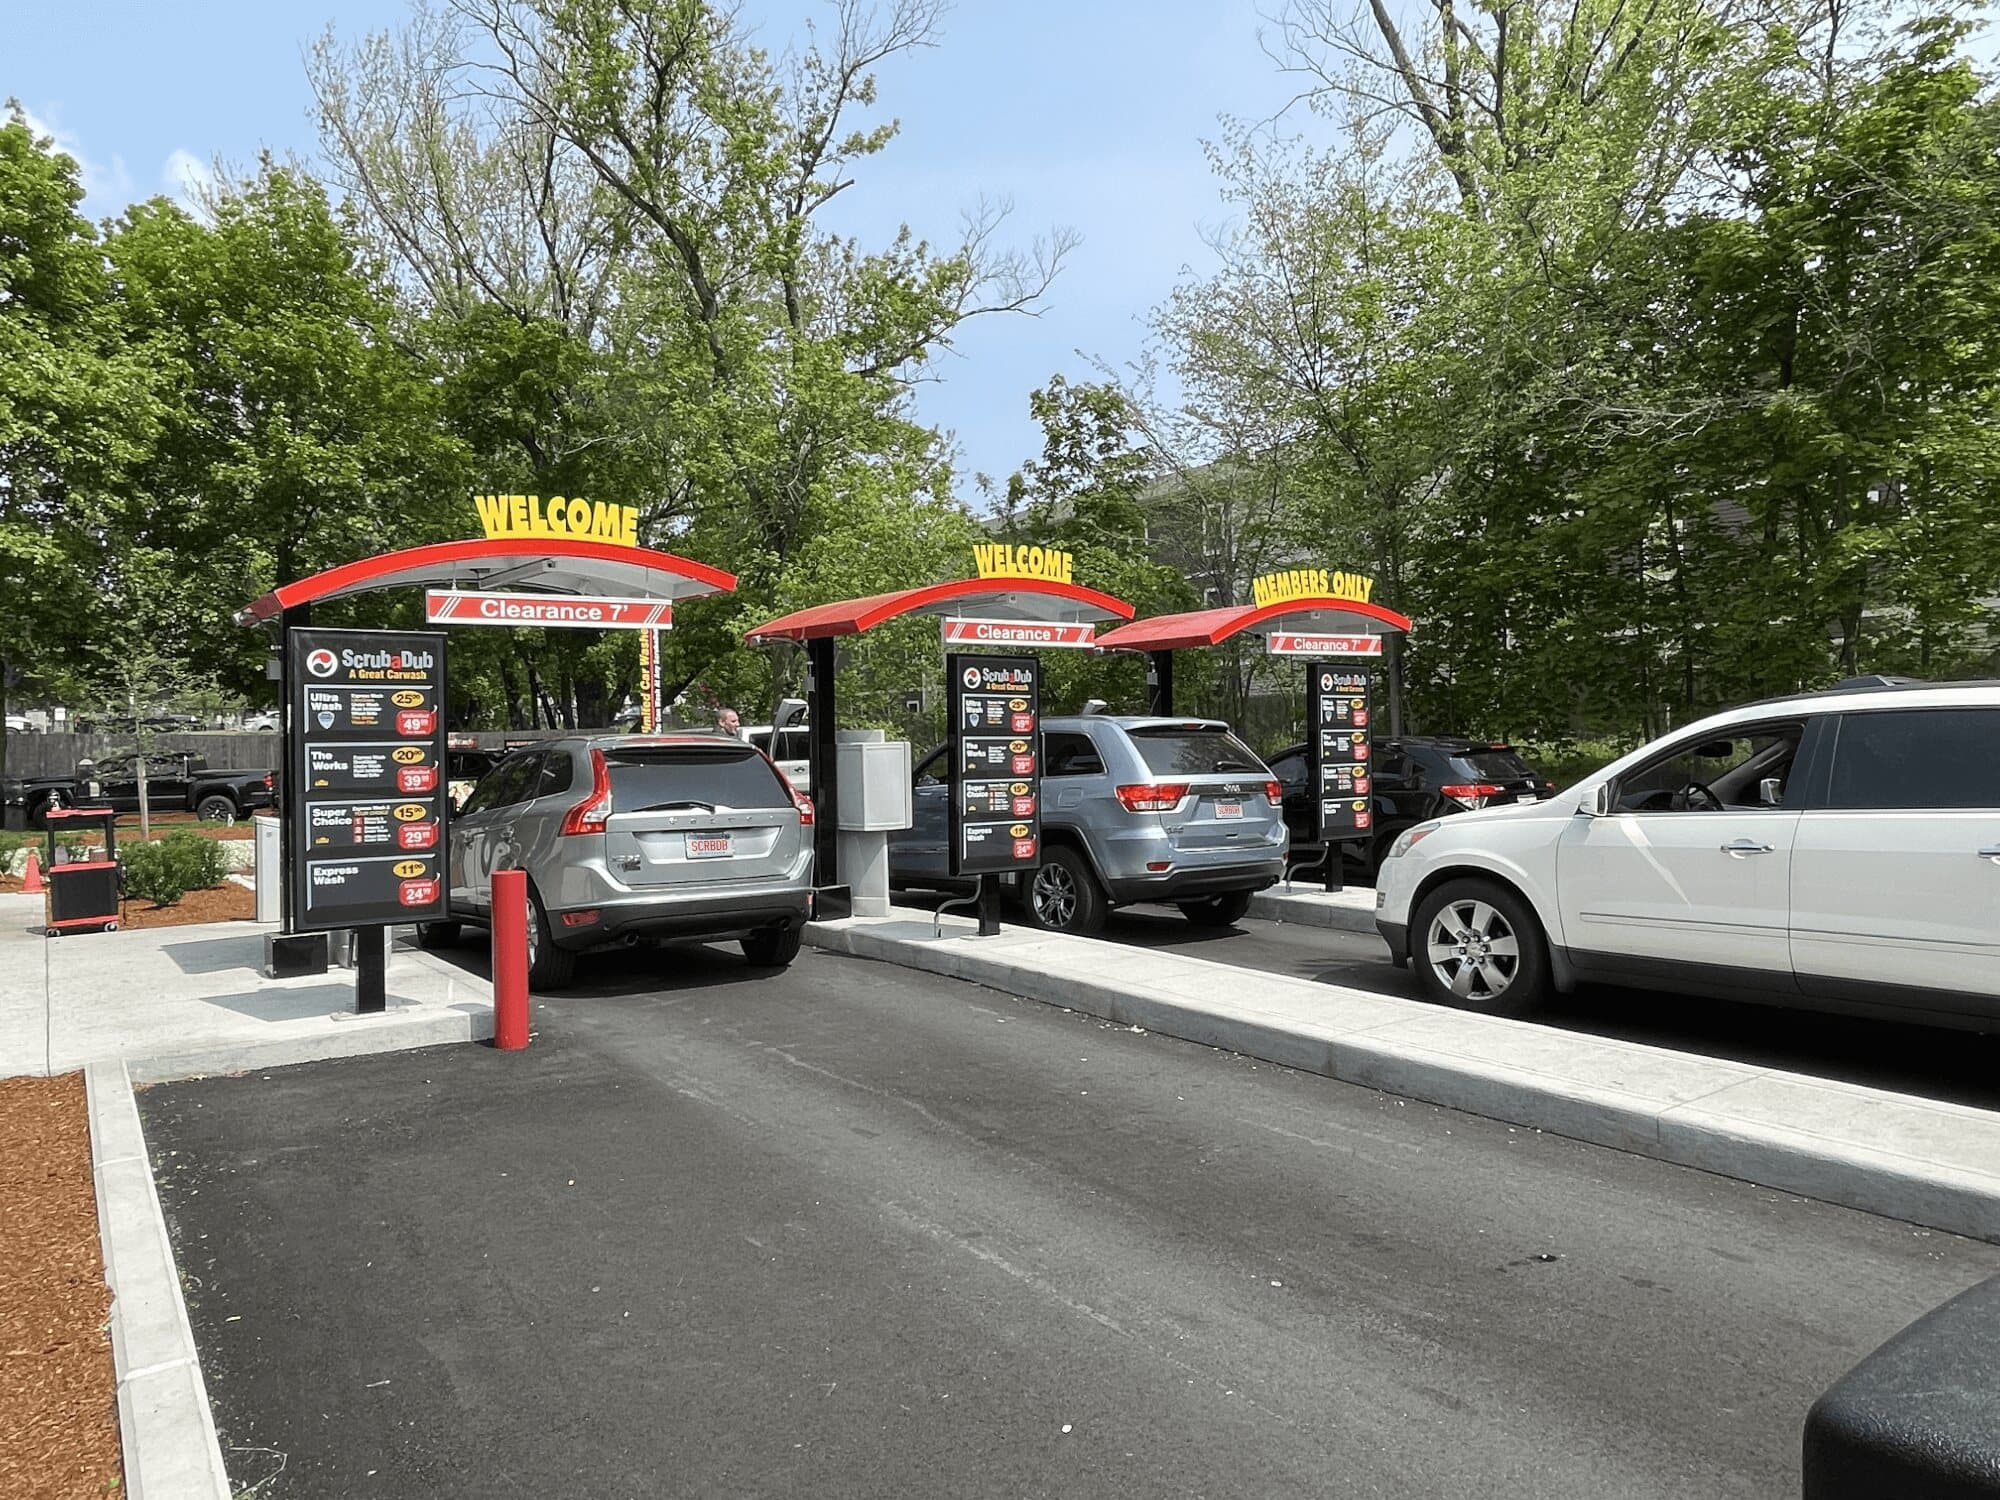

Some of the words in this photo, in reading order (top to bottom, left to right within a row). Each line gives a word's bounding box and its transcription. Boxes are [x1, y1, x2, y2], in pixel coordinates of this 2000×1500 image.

[474, 495, 639, 546] WELCOME
[973, 544, 1073, 583] WELCOME
[1253, 569, 1329, 608] MEMBERS
[1333, 571, 1373, 604] ONLY
[480, 600, 602, 621] Clearance
[609, 604, 628, 621] 7'
[977, 624, 1051, 641] Clearance
[1293, 637, 1348, 651] Clearance
[342, 649, 434, 670] ScrubaDub
[349, 669, 357, 679] A
[358, 669, 385, 680] Great
[386, 670, 427, 680] Carwash
[640, 668, 650, 690] Car
[310, 693, 339, 702] Ultra
[310, 702, 342, 711] Wash
[311, 751, 333, 760] The
[312, 761, 349, 771] Works
[312, 808, 347, 819] Super
[312, 817, 352, 826] Choice
[313, 866, 359, 877] Express
[313, 875, 346, 885] Wash
